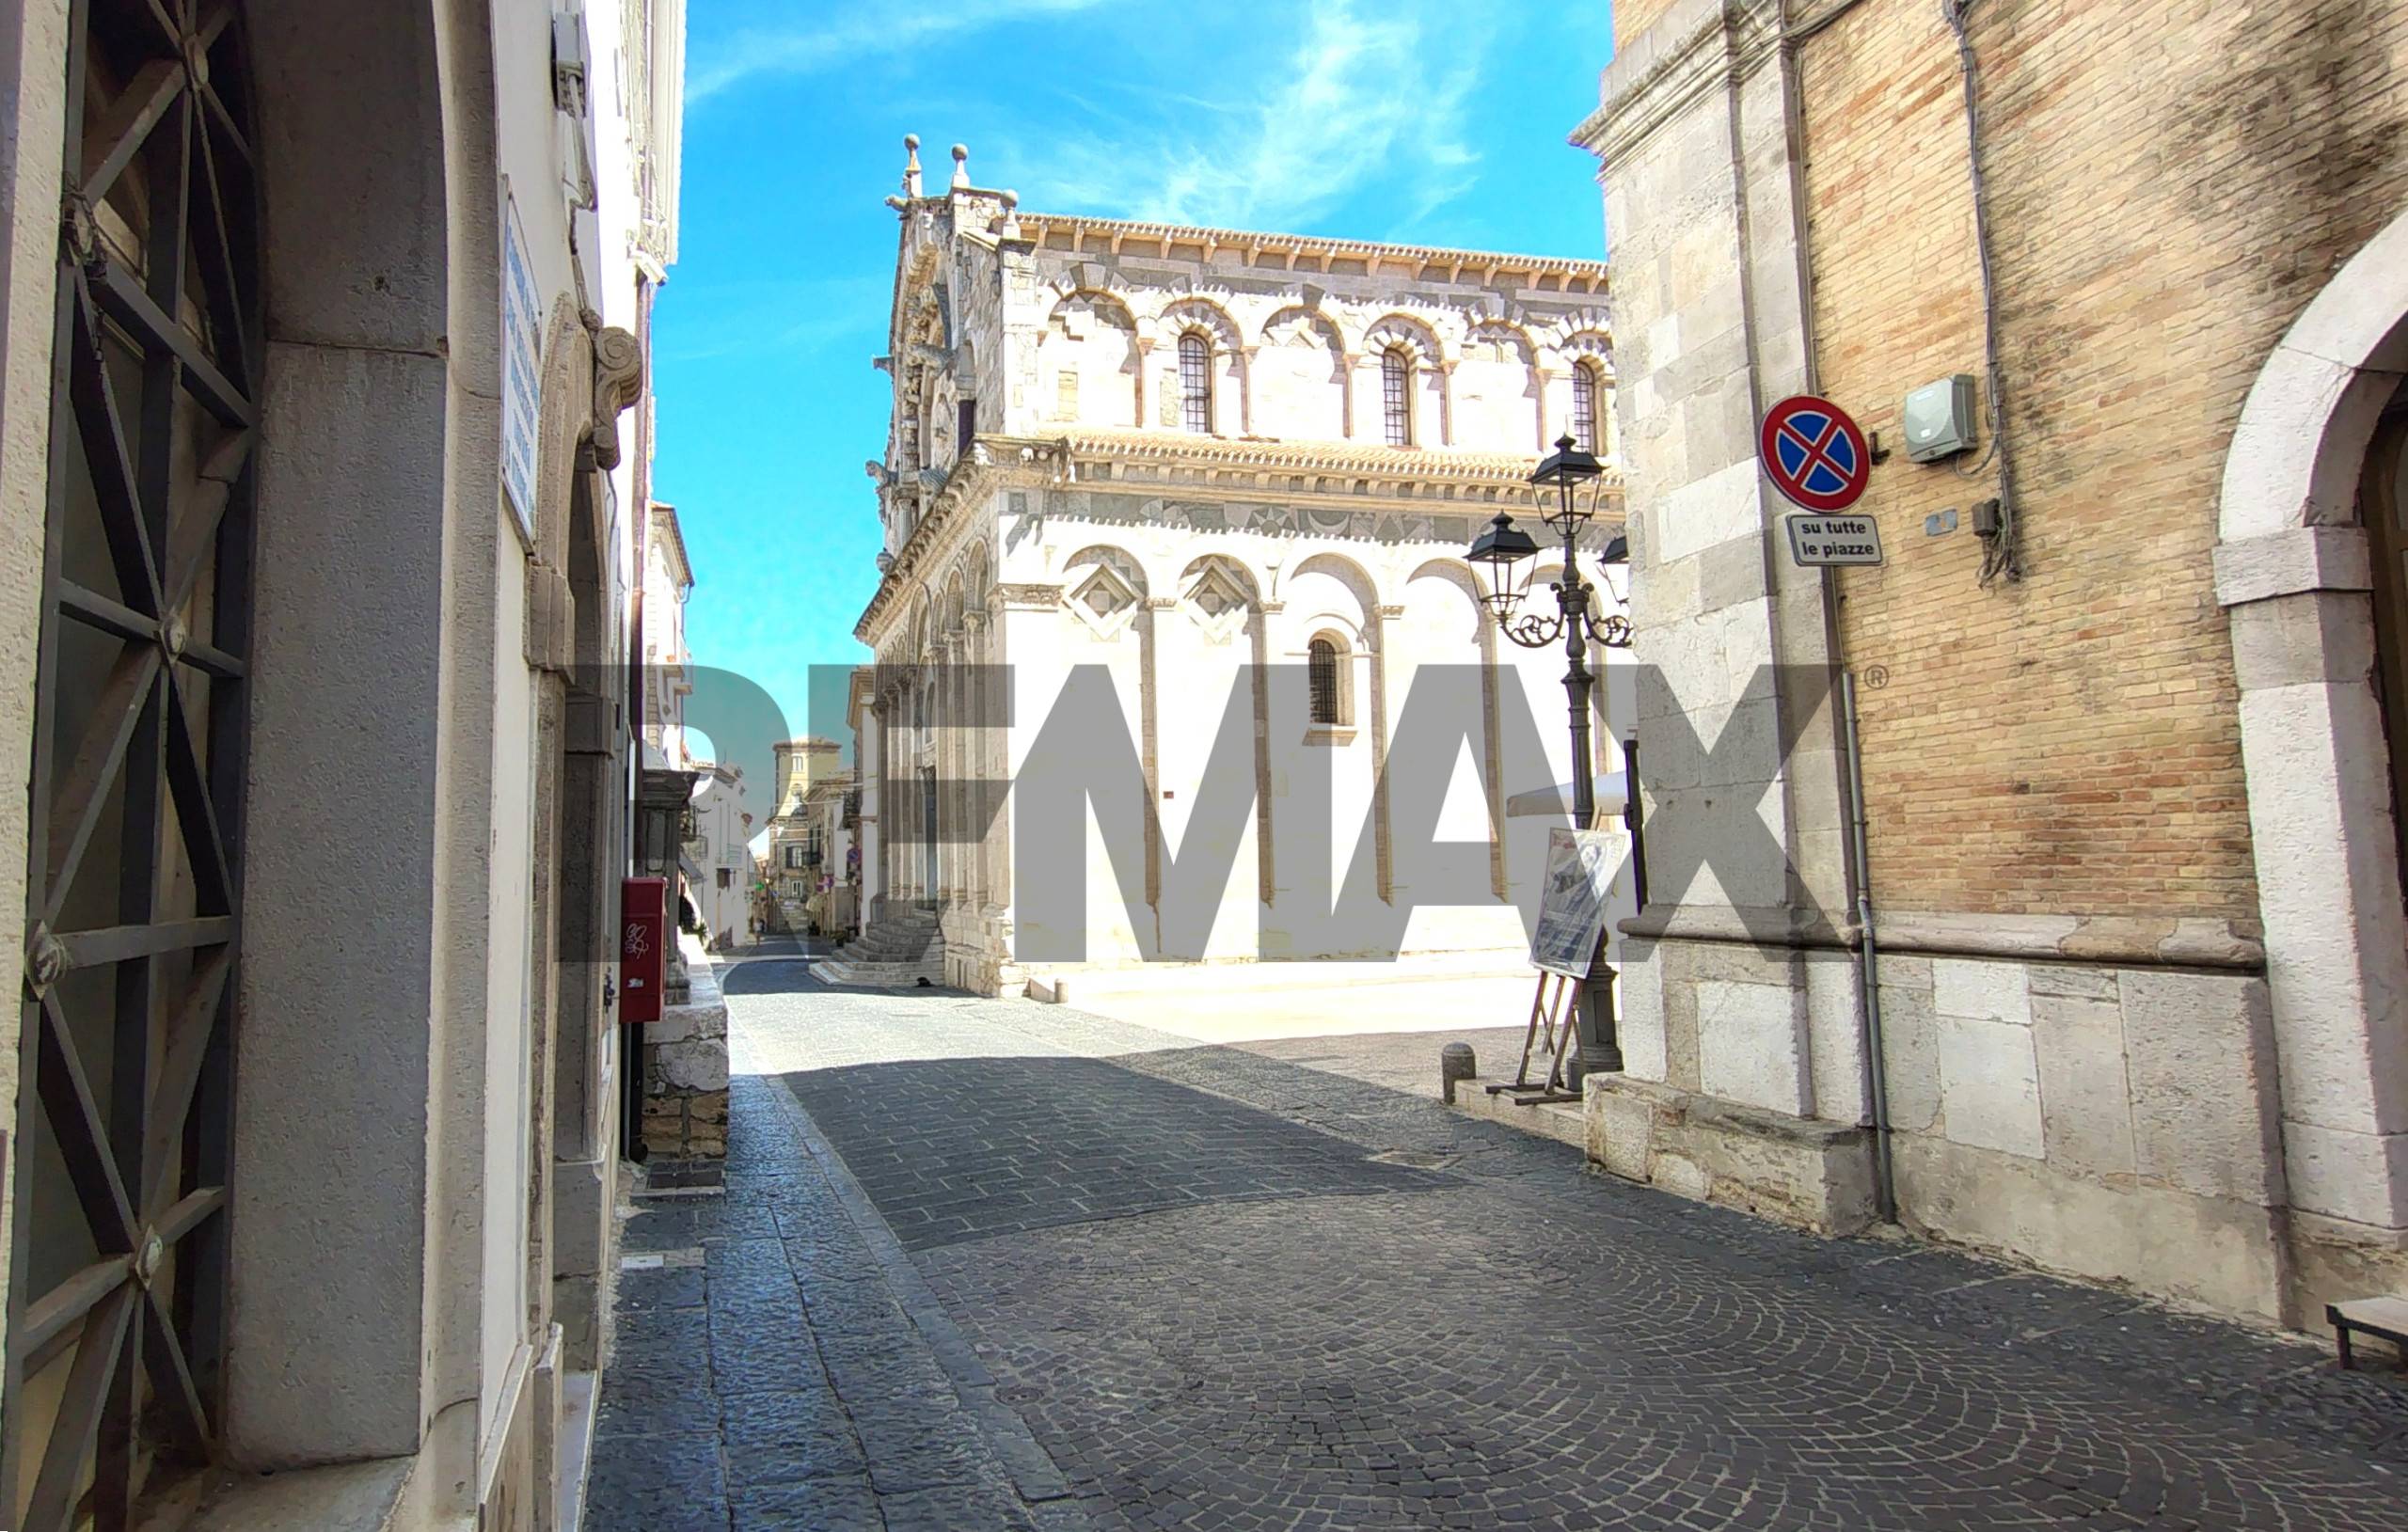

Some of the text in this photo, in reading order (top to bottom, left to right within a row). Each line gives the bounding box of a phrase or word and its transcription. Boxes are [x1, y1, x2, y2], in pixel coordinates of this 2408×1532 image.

[1801, 521, 1866, 534] su tutte
[1802, 542, 1875, 558] le piazze
